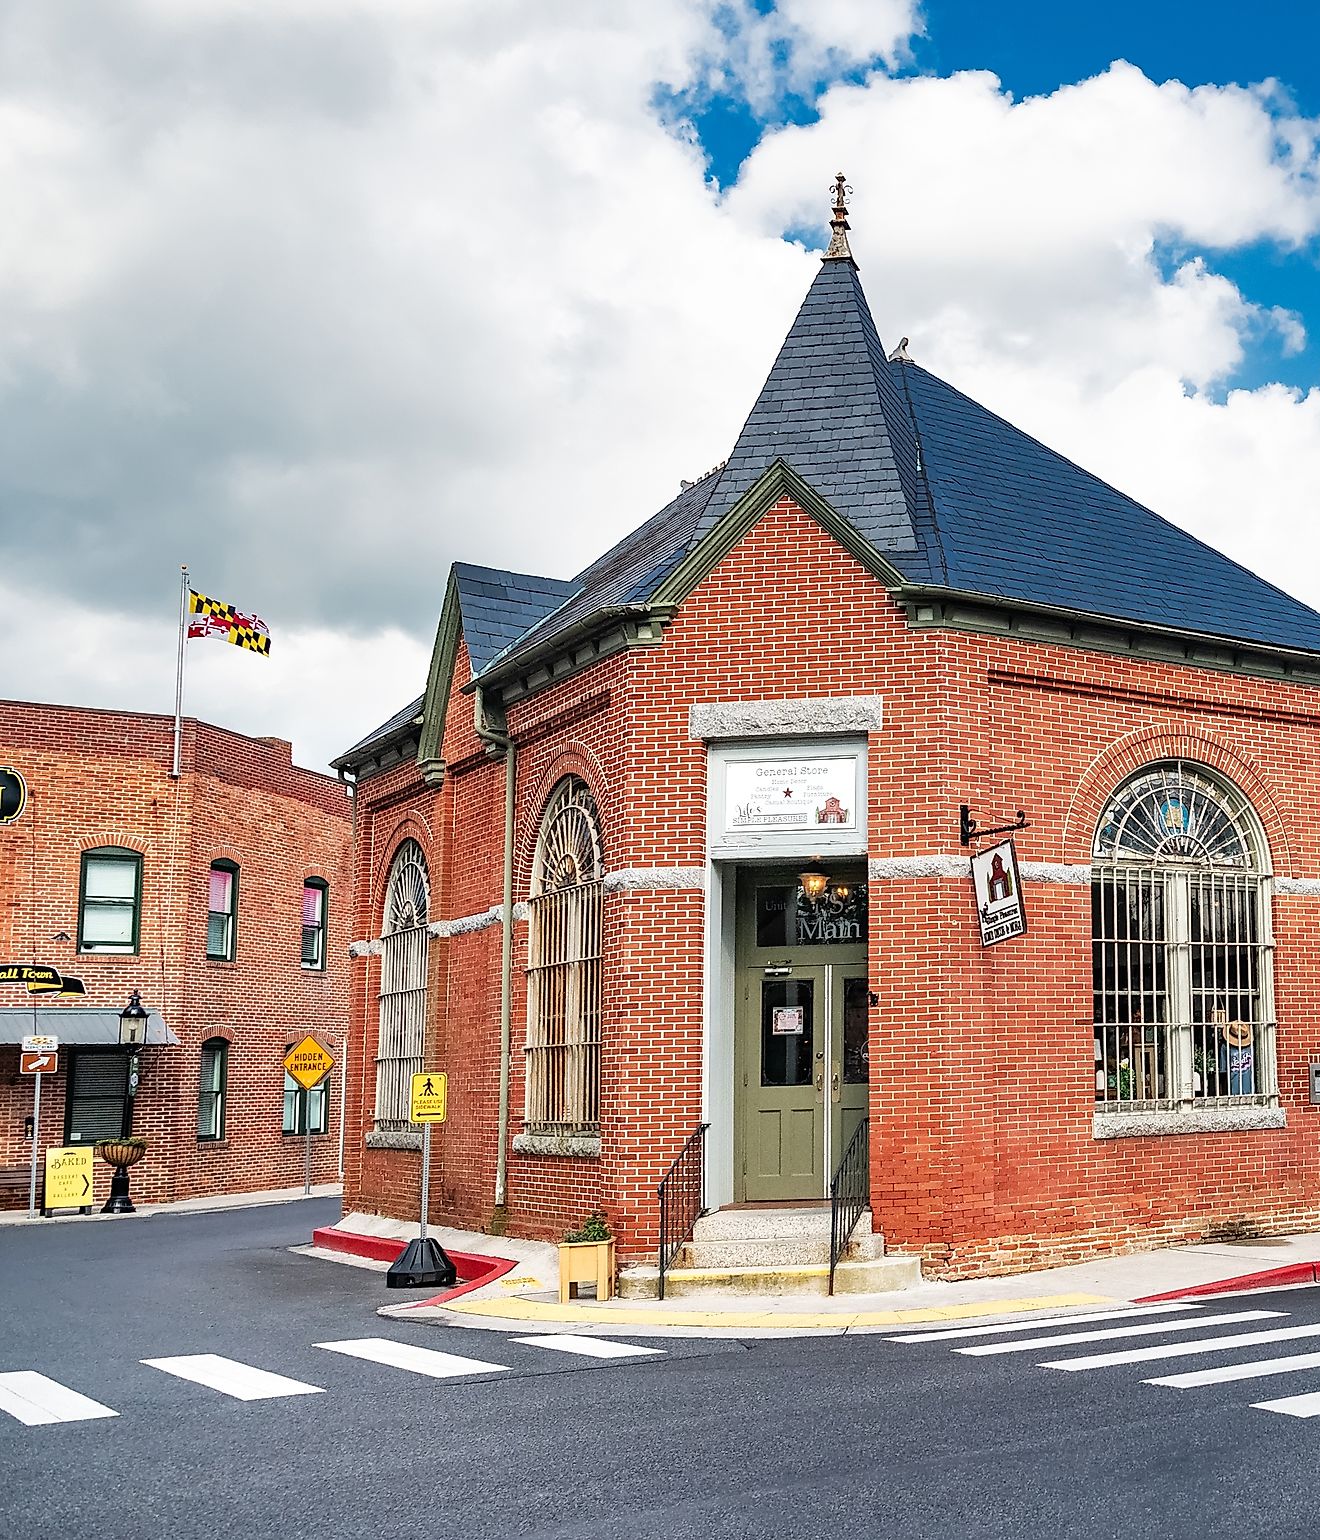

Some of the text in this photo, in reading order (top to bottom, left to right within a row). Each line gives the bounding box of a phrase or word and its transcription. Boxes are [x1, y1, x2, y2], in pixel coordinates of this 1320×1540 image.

[756, 766, 829, 777] General Store
[796, 916, 862, 941] Main
[21, 967, 54, 979] Town
[294, 1052, 323, 1062] HIDDEN
[290, 1062, 328, 1072] ENTRANCE
[51, 1157, 87, 1170] BAKED
